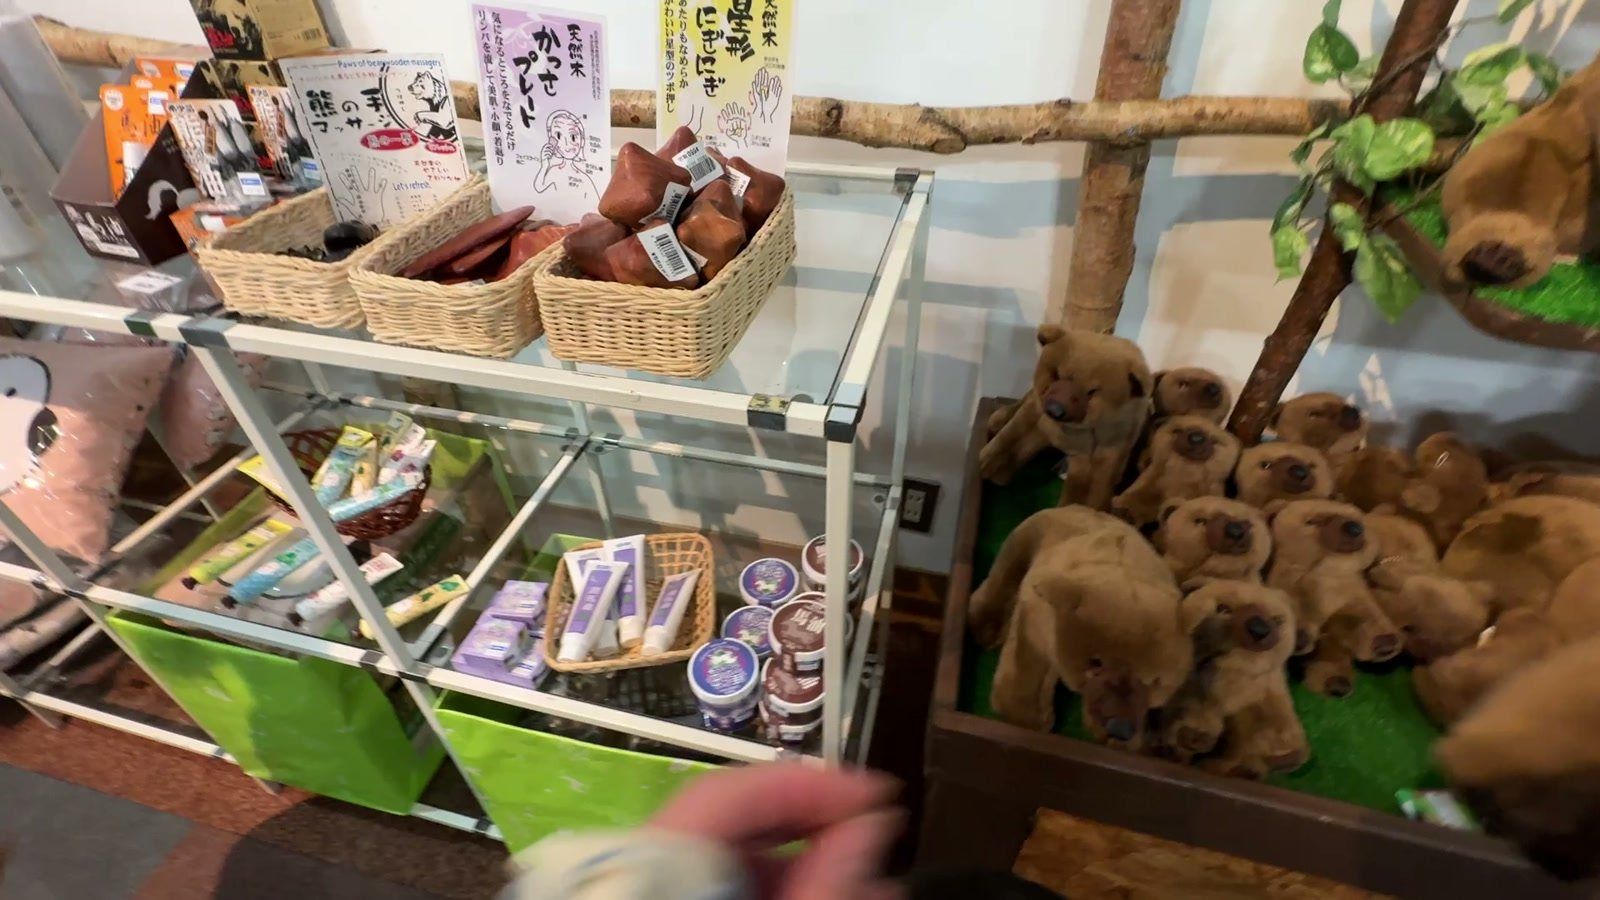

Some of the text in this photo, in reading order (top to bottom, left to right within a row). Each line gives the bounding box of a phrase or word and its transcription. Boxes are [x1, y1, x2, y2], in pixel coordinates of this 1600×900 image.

[532, 25, 562, 97] かっさ
[566, 23, 586, 79] 天然木
[696, 6, 726, 98] にぎにぎ
[725, 0, 756, 62] 星形
[338, 60, 357, 69] Paws
[358, 59, 366, 68] of
[491, 11, 516, 151] 気になるところをなでるだけ
[513, 51, 538, 129] プレート
[305, 88, 384, 119] 熊の手
[311, 113, 392, 134] マッサージ
